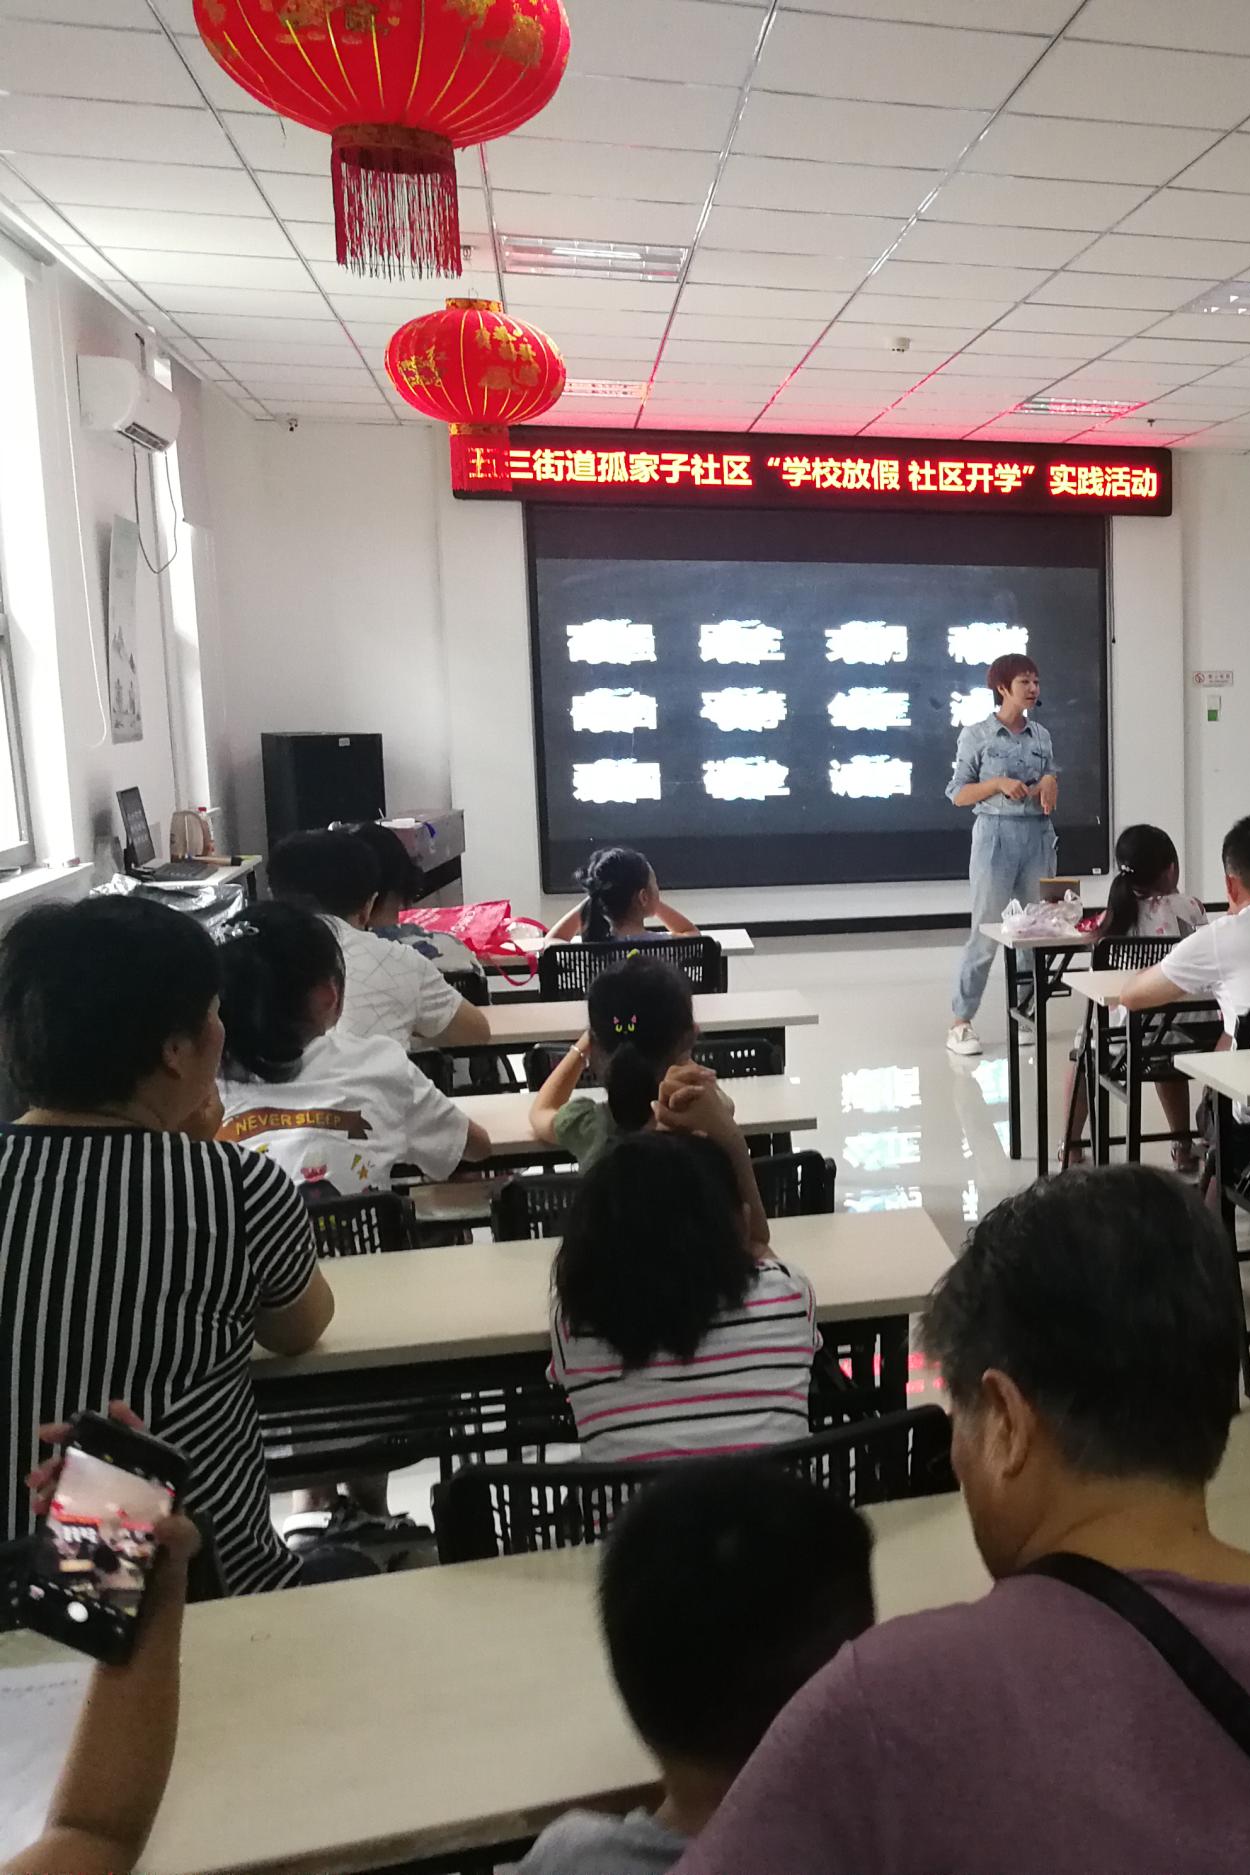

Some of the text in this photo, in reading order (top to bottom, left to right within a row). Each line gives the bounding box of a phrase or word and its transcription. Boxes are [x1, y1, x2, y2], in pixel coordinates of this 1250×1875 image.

[1049, 464, 1158, 497] 实践活动
[235, 1111, 342, 1136] NEVER SLEEP
